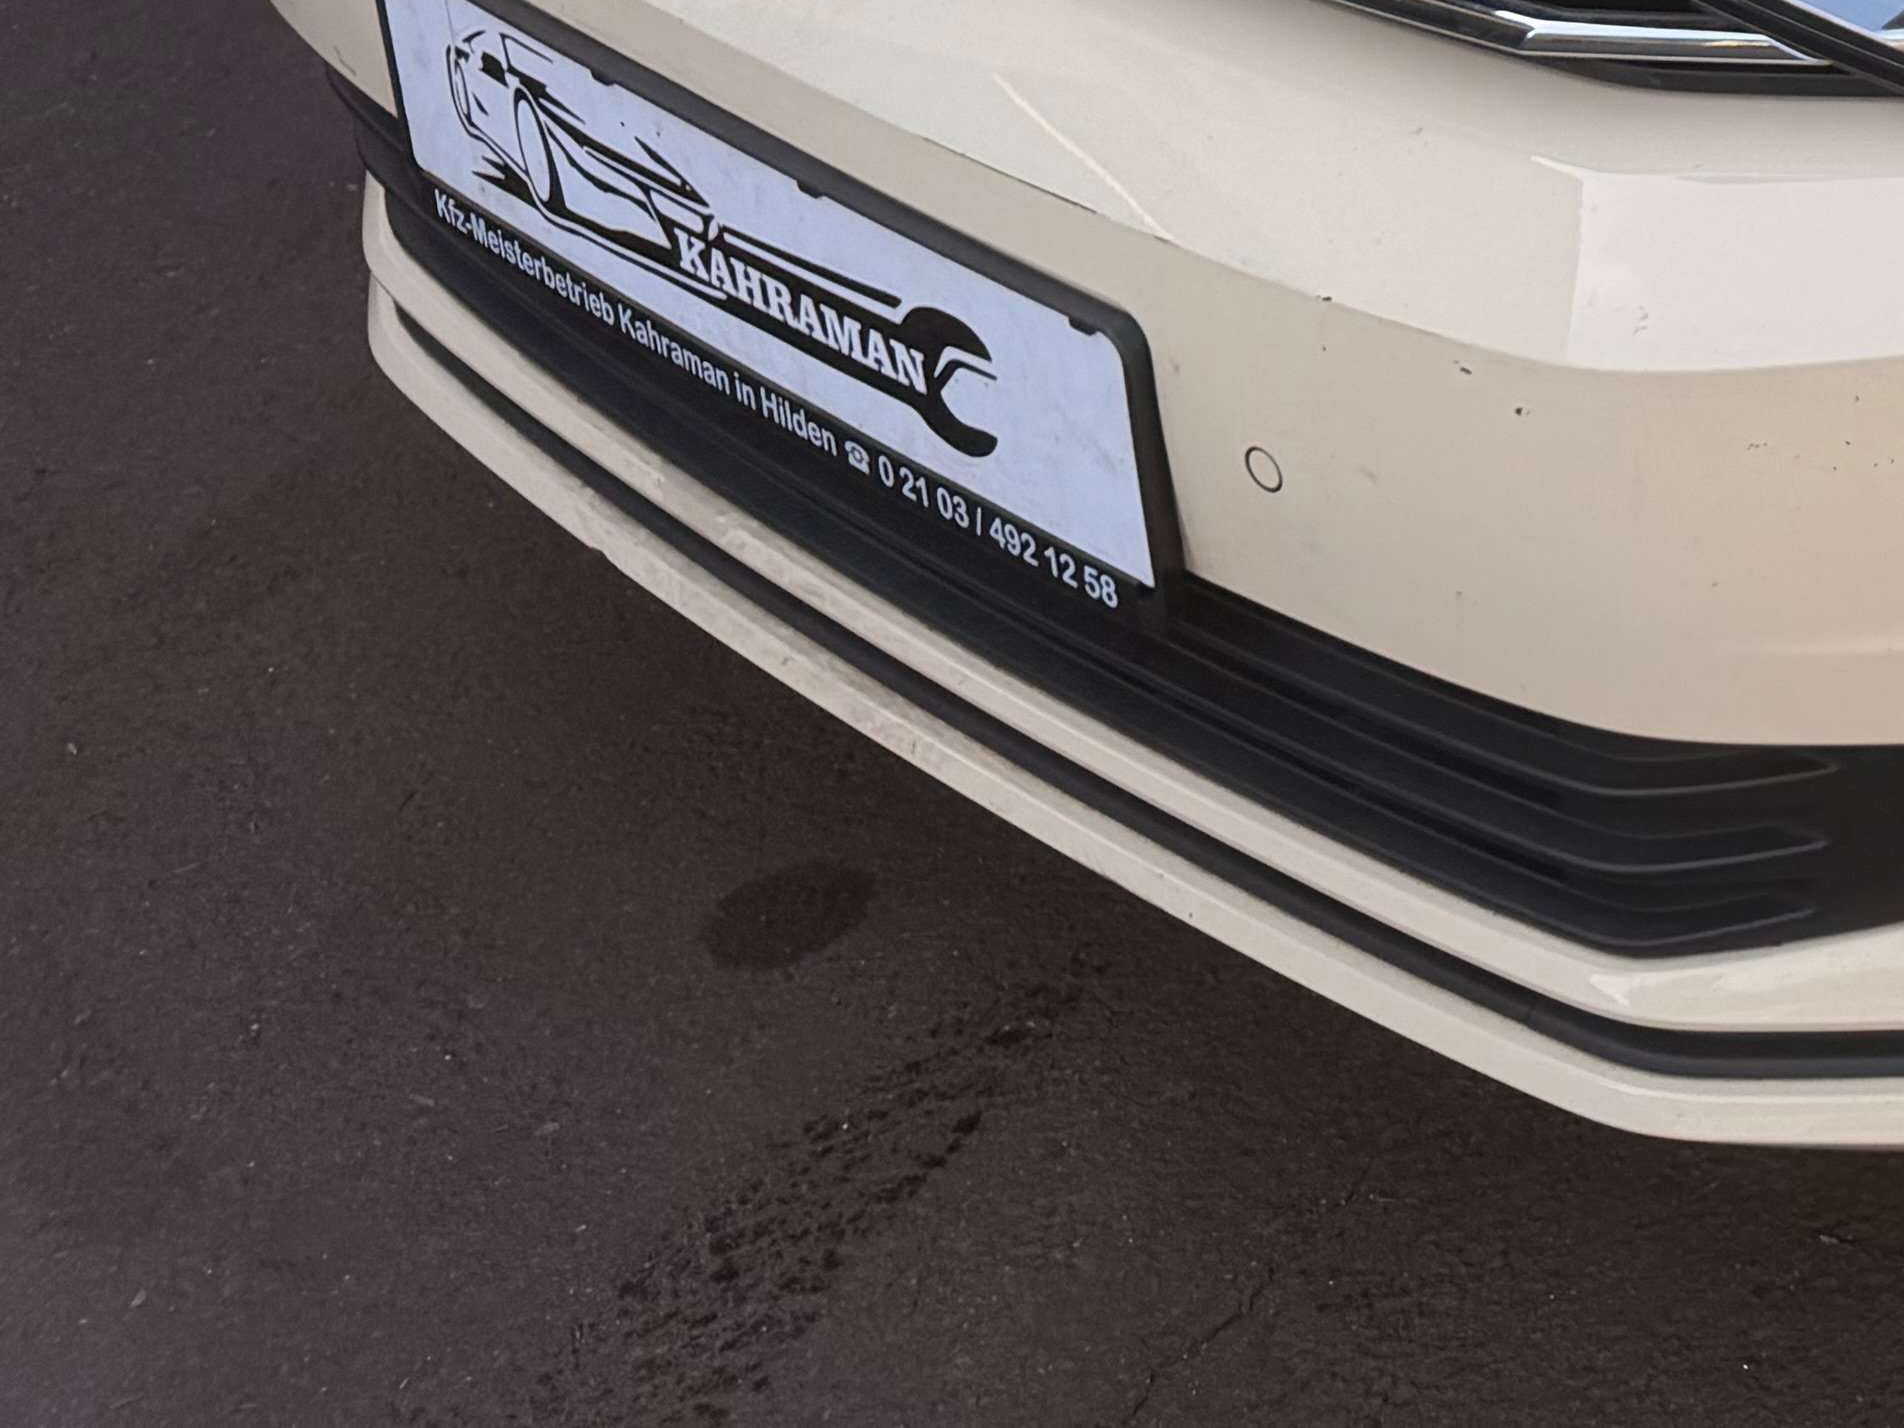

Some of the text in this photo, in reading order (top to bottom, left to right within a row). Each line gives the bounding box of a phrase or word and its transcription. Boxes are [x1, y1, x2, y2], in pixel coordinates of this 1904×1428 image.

[434, 188, 615, 327] Kfz-Meisterbetrieb
[618, 303, 730, 395] Kahraman
[733, 371, 757, 410] in
[760, 386, 838, 457] Hilden
[877, 456, 895, 488] 0
[900, 466, 929, 508] 21
[936, 487, 970, 529] 03
[989, 517, 1040, 567] 492
[1044, 546, 1079, 589] 12
[1083, 565, 1119, 609] 58
[674, 228, 928, 395] KAHRAMAN
